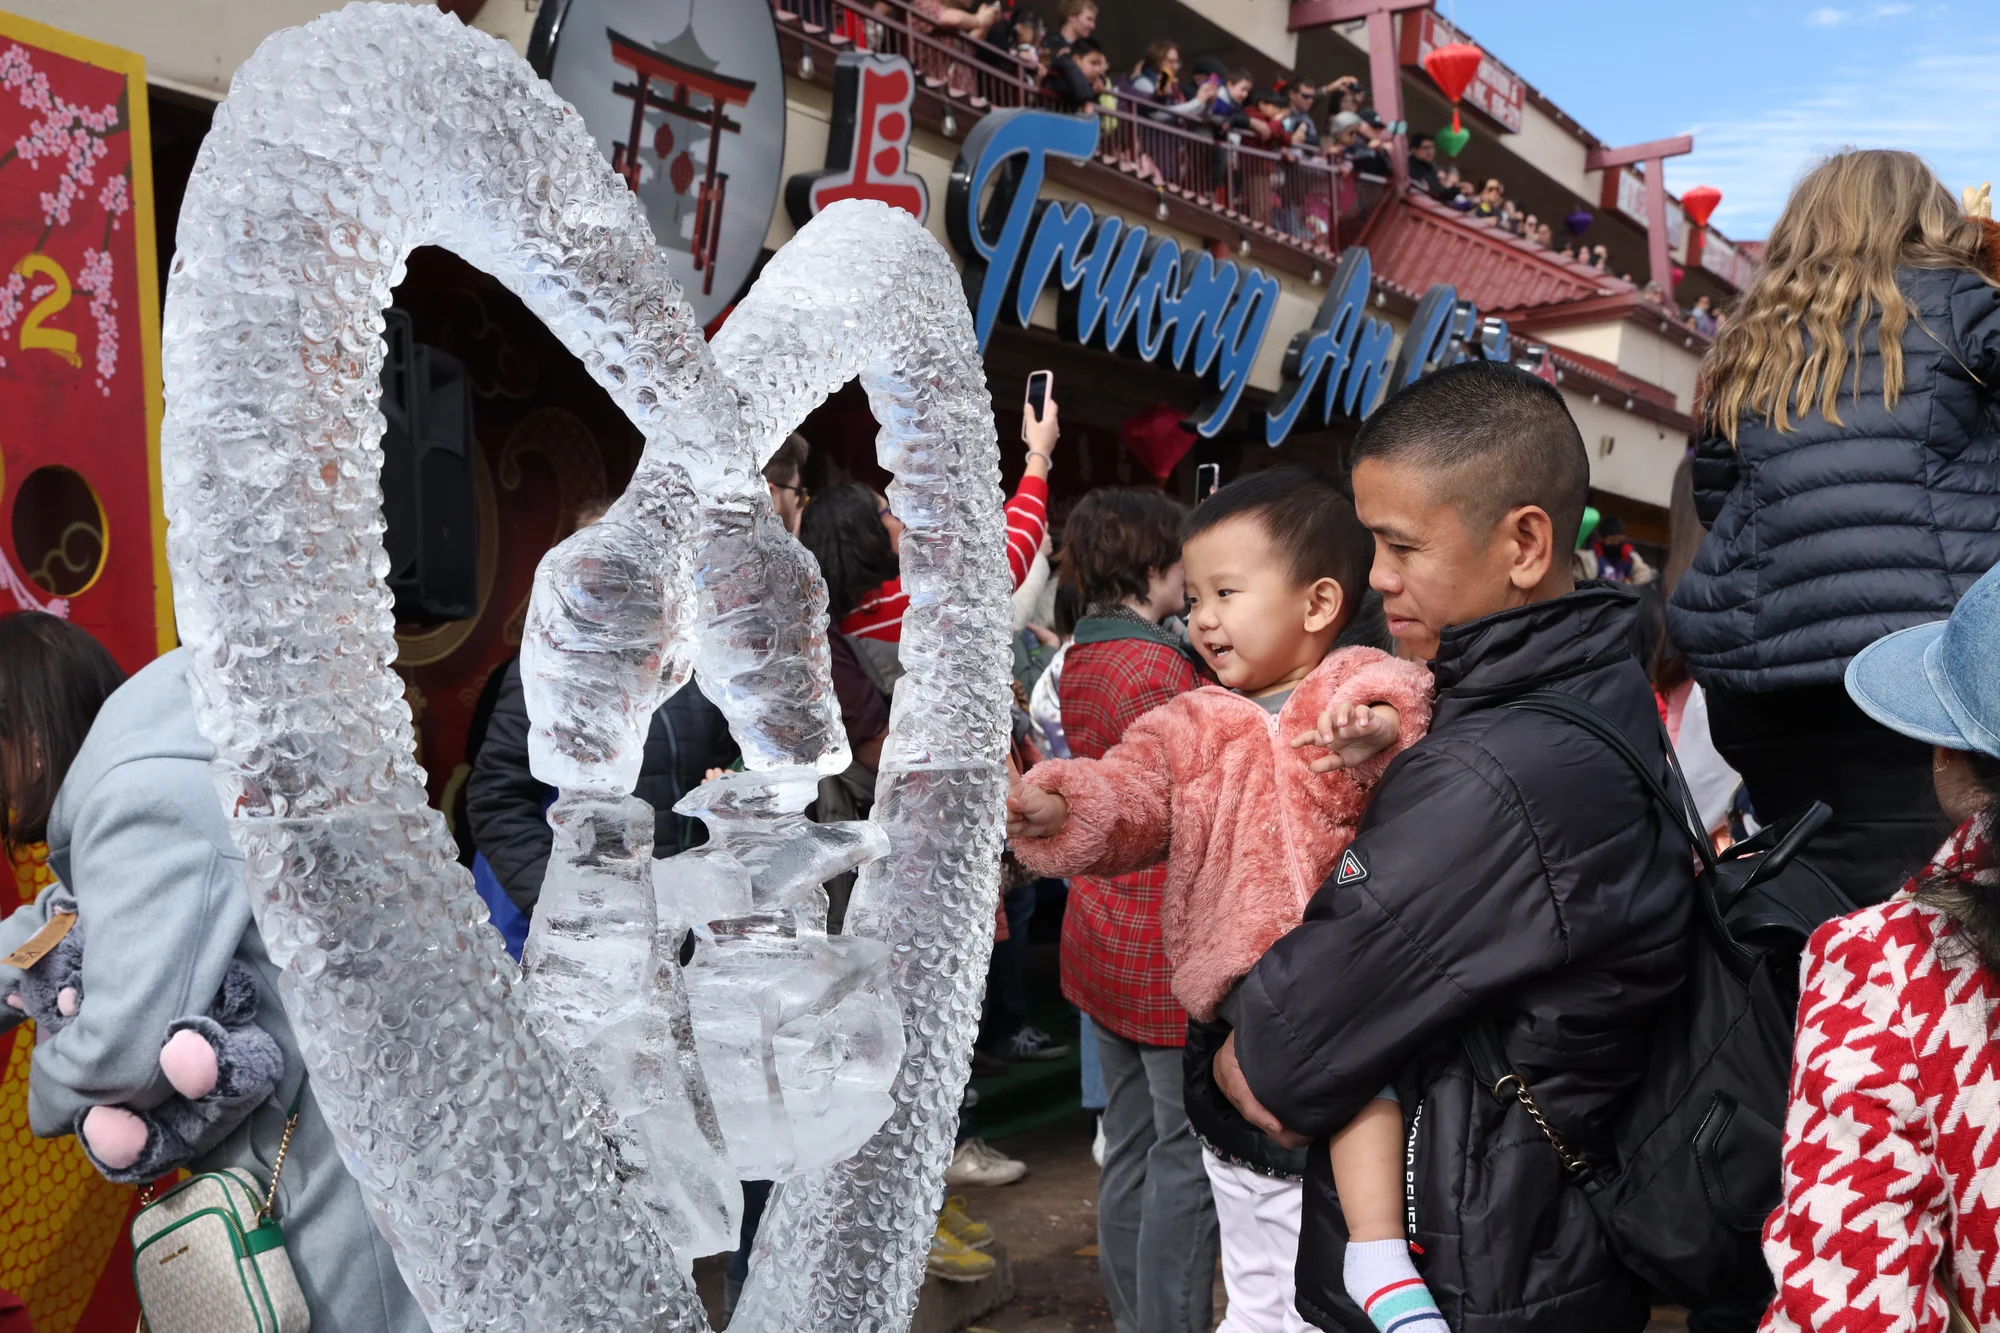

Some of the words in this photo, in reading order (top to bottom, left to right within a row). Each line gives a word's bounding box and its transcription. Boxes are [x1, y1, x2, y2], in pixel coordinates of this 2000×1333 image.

[14, 252, 82, 368] 2
[968, 112, 1281, 438] Truong
[1265, 248, 1394, 449] An
